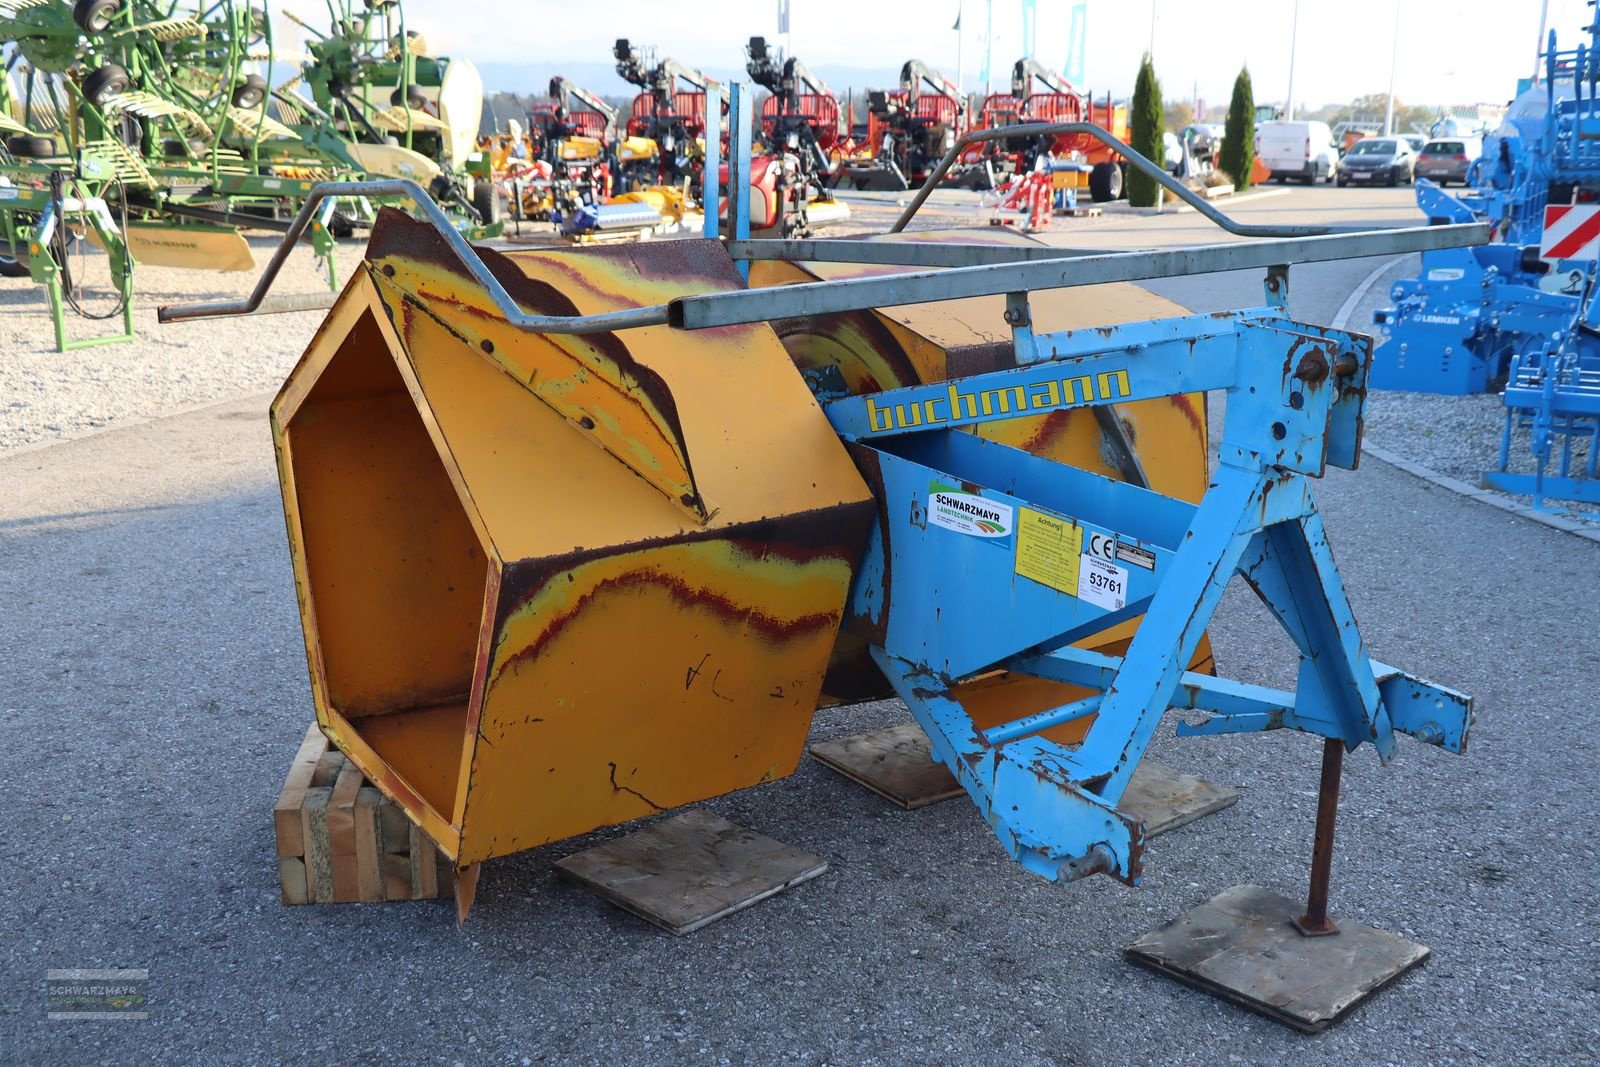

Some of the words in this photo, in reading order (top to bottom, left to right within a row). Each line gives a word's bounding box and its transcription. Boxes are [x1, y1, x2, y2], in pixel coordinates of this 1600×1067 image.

[1422, 315, 1460, 325] LEMKEN
[866, 369, 1131, 432] buchmann
[936, 494, 1000, 523] SCHWARZMAYR
[936, 505, 974, 523] LANDTECHNIK
[1090, 535, 1113, 560] CE
[1089, 572, 1122, 595] 53761
